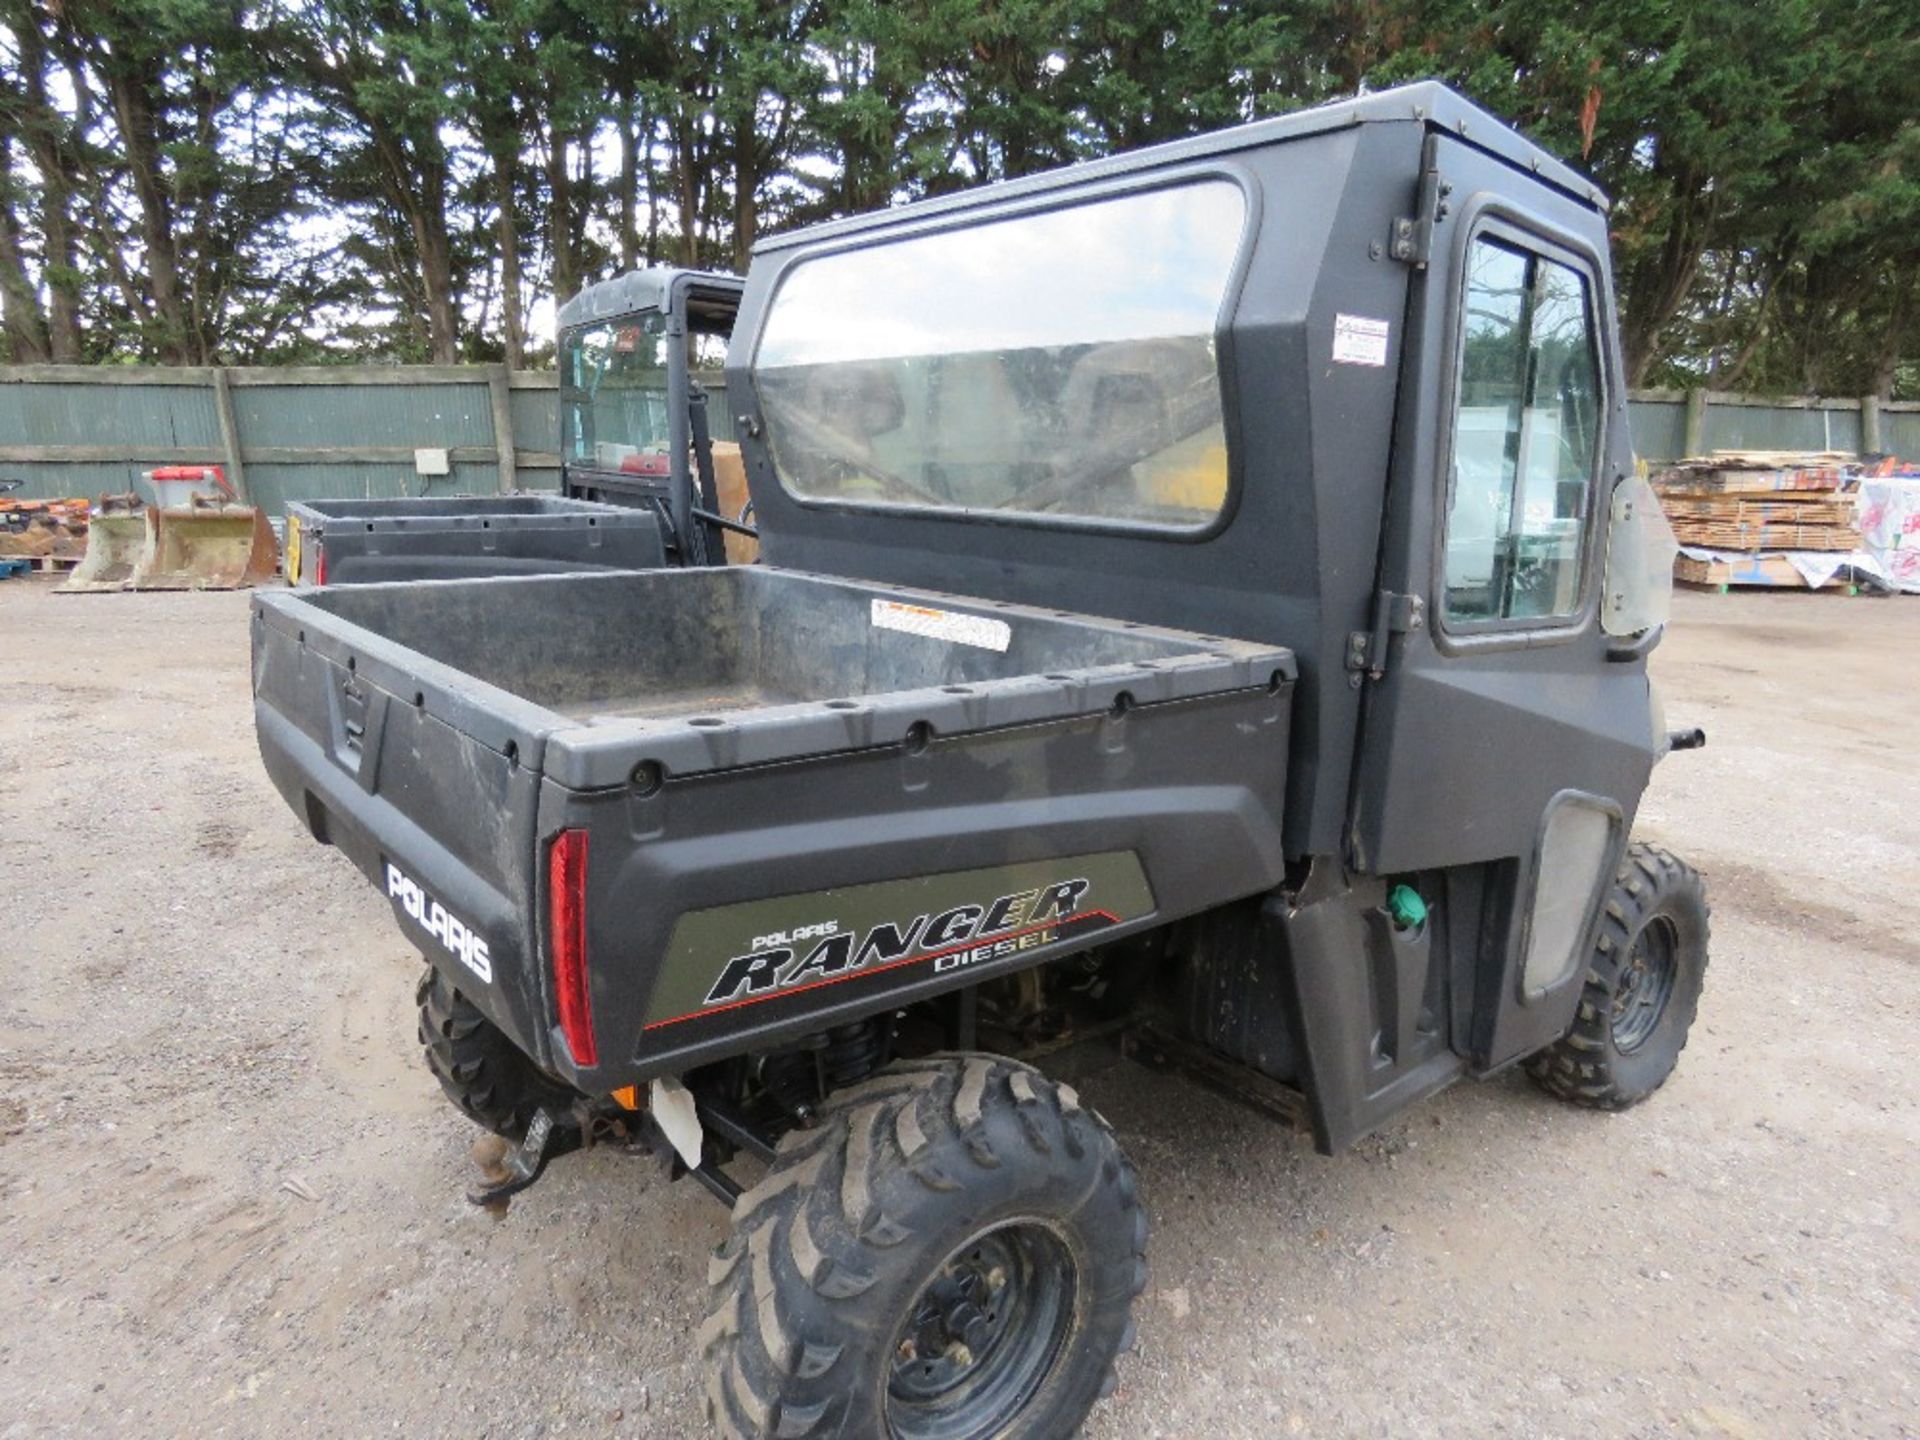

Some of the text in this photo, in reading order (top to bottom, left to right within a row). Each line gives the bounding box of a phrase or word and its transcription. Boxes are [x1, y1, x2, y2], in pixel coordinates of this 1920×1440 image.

[386, 863, 492, 984] POLARIS
[702, 879, 1089, 1004] RANGER
[751, 920, 838, 950] POLARIS
[934, 930, 1058, 972] DIESEL
